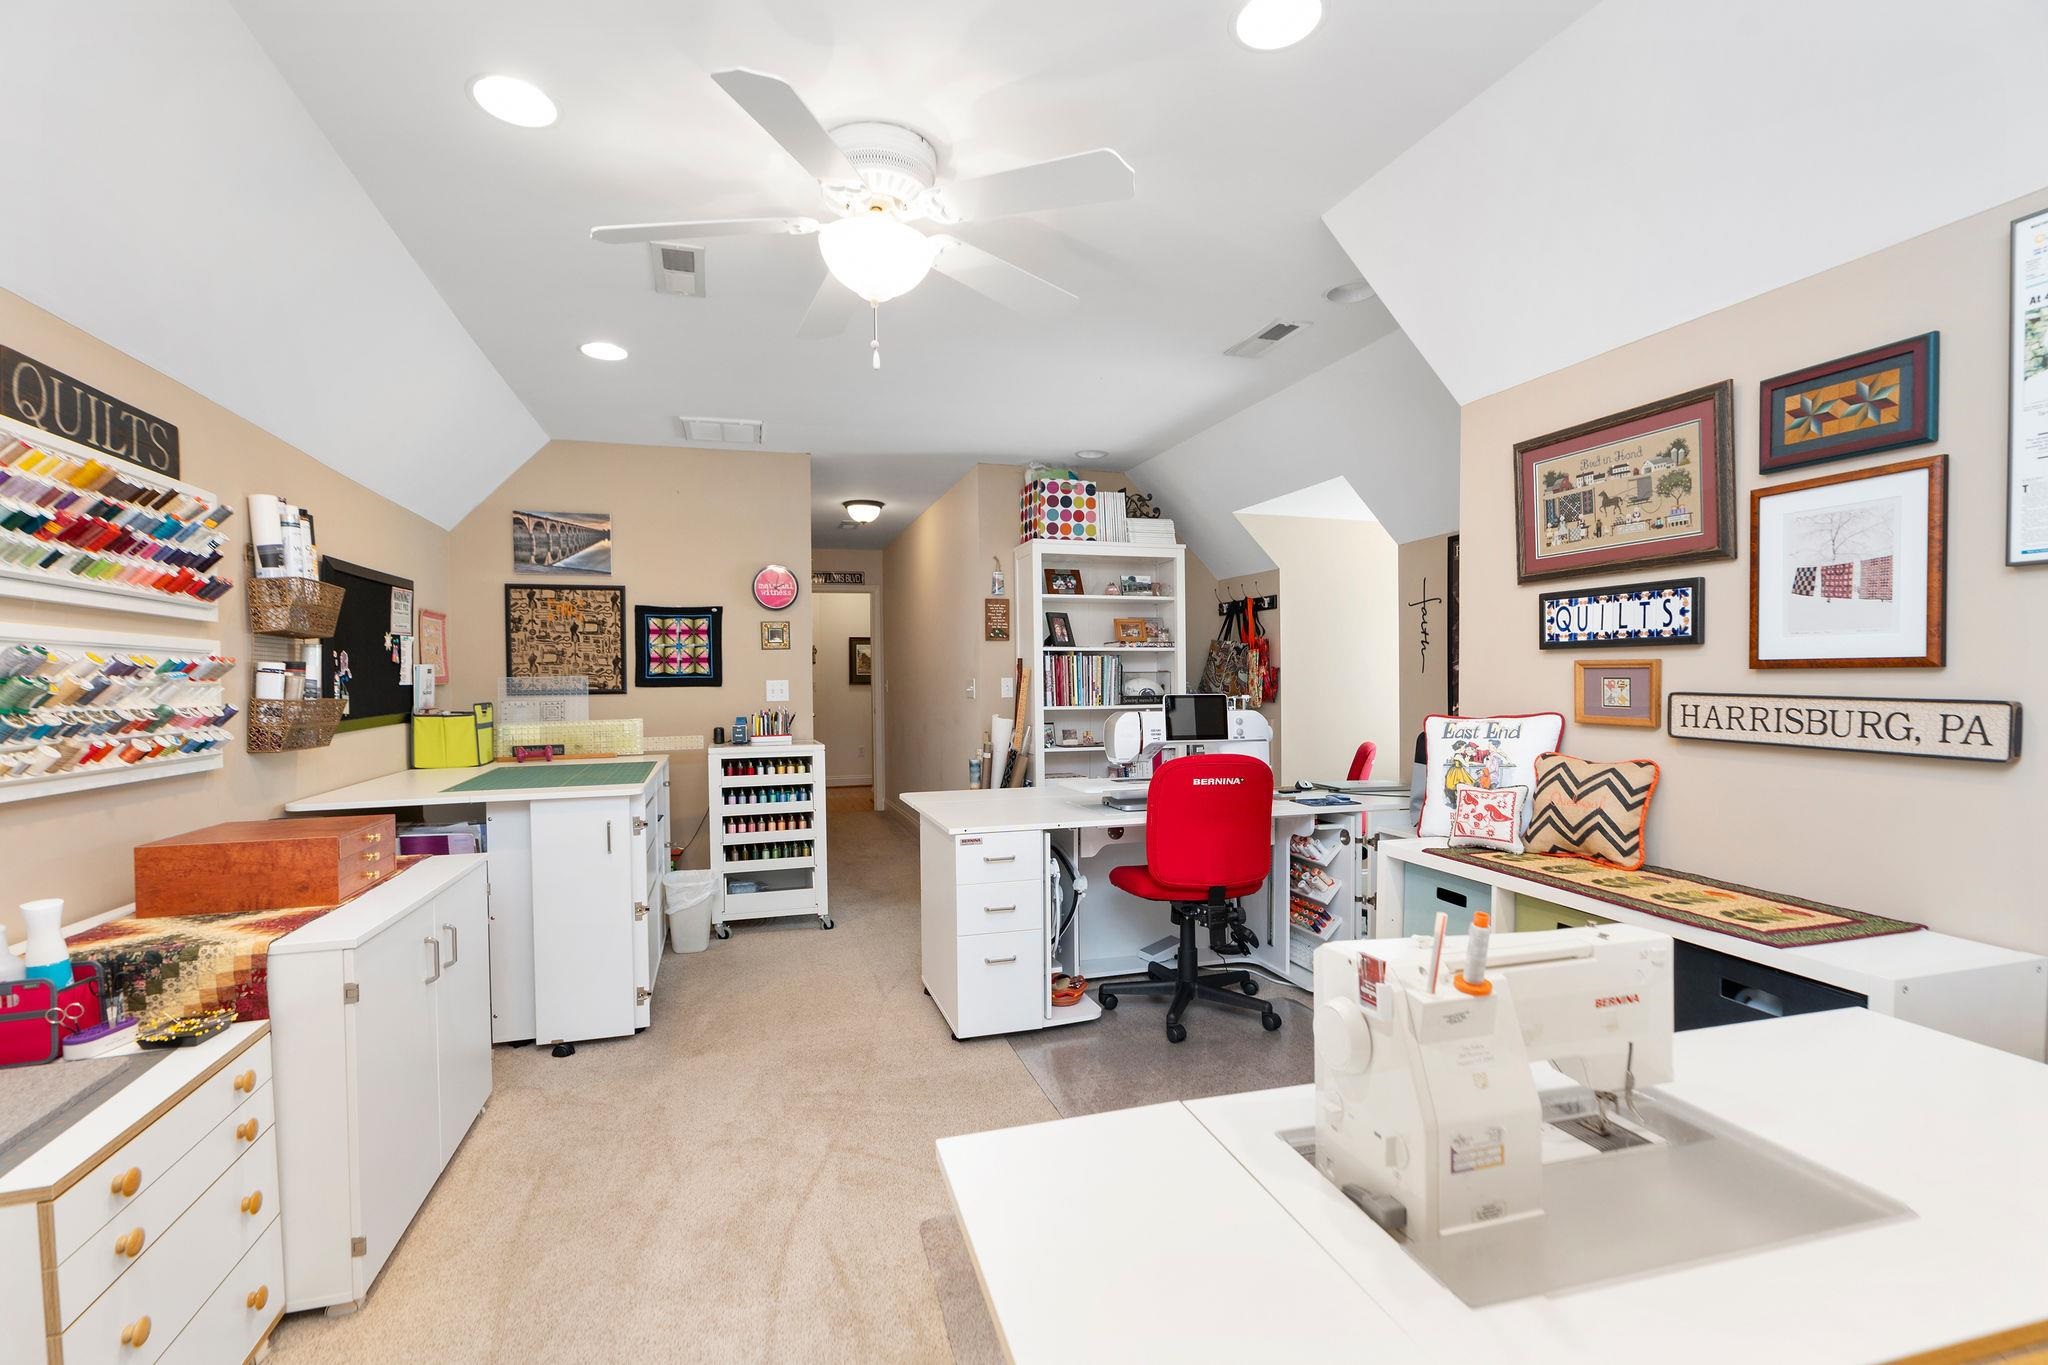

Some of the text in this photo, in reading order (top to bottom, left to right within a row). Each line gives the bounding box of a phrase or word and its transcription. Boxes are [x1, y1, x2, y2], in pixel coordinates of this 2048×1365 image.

[12, 362, 169, 471] QUILTS
[1614, 445, 1643, 463] Hand
[1408, 577, 1442, 674] faith
[1556, 598, 1673, 632] QUILTS
[1441, 722, 1522, 740] East End
[1680, 703, 1994, 746] HARRISBURG, PA
[1193, 777, 1241, 786] BERNINA
[1595, 994, 1640, 1008] BERNINA
